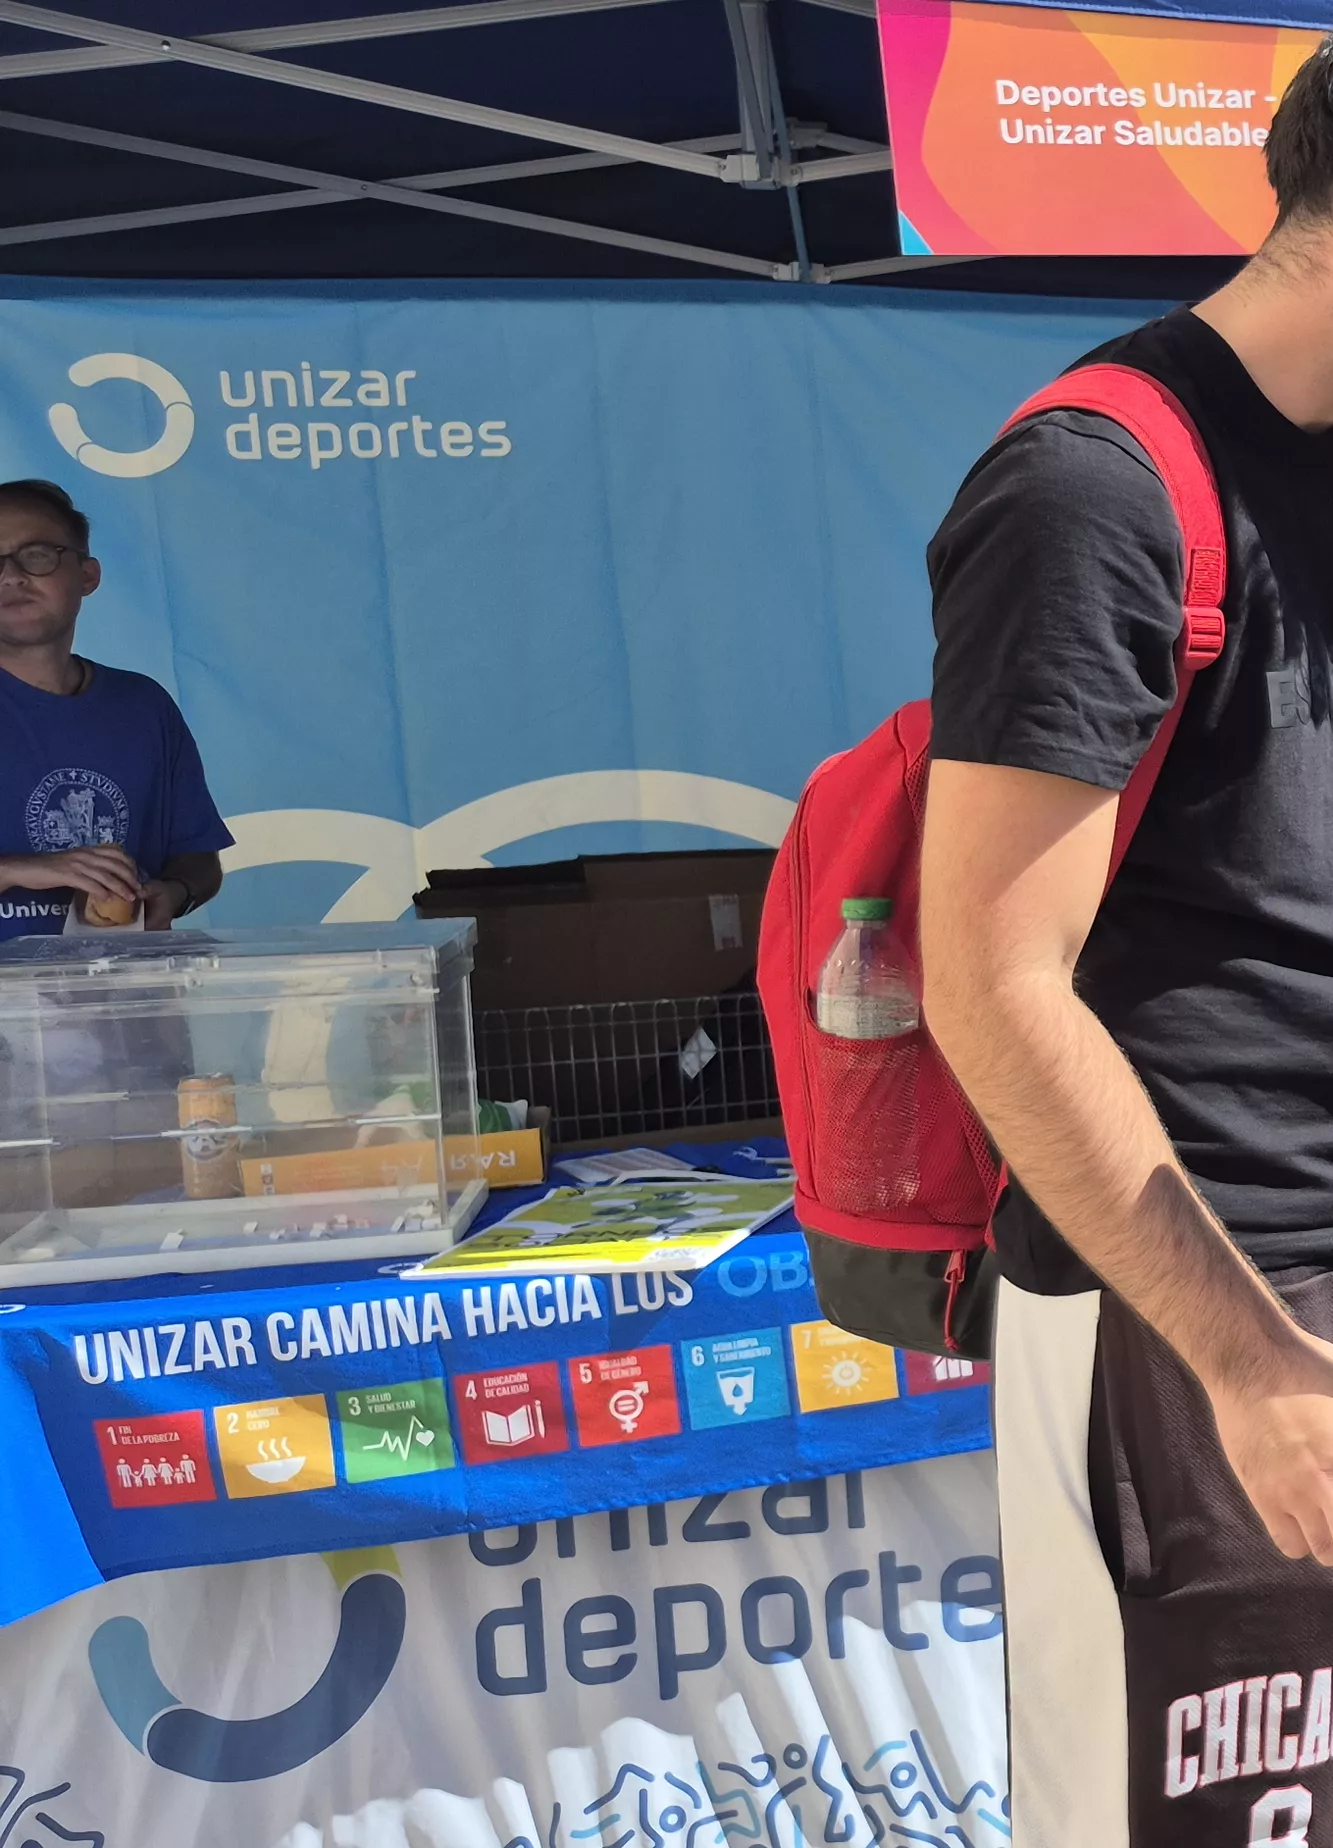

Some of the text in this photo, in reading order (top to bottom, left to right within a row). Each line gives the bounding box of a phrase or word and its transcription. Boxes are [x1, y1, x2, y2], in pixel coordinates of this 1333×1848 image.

[995, 79, 1147, 112] Deportes
[1153, 82, 1256, 109] Unizar
[1000, 117, 1269, 147] Unizar Saludable
[219, 361, 417, 409] unizar
[224, 413, 512, 470] deportes
[74, 1317, 257, 1385] UNIZAR
[266, 1292, 452, 1362] CAMINA
[462, 1274, 601, 1337] HACIA
[611, 1269, 694, 1315] LOS
[691, 1345, 705, 1367] 6
[579, 1362, 592, 1384] 5
[465, 1379, 478, 1401] 4
[347, 1396, 362, 1416] 3
[106, 1425, 117, 1446] 1
[226, 1412, 240, 1434] 2
[475, 1550, 1003, 1700] deporte
